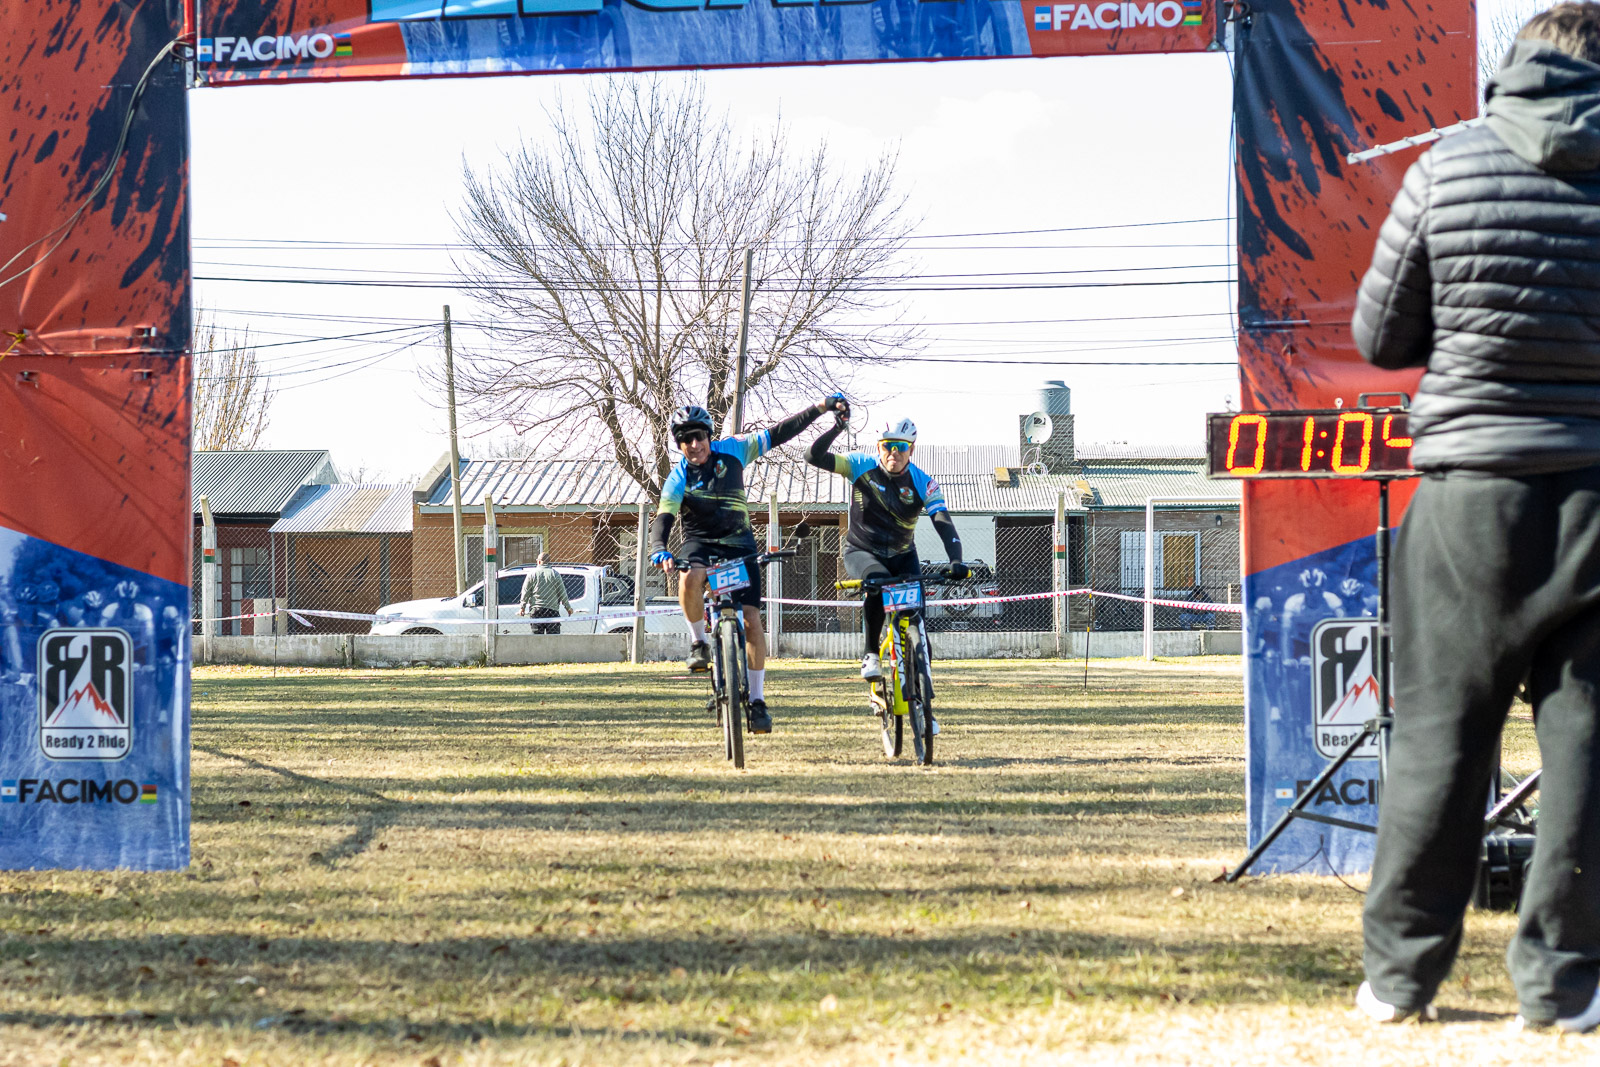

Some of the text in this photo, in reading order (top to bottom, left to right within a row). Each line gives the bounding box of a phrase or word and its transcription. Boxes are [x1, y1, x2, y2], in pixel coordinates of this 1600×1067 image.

[1053, 0, 1183, 31] FACIMO
[214, 33, 334, 62] FACIMO
[716, 567, 741, 589] 62
[888, 588, 918, 606] 178
[46, 735, 126, 750] Ready 2 Ride
[1322, 733, 1365, 747] Rea
[19, 779, 139, 804] FACIMO
